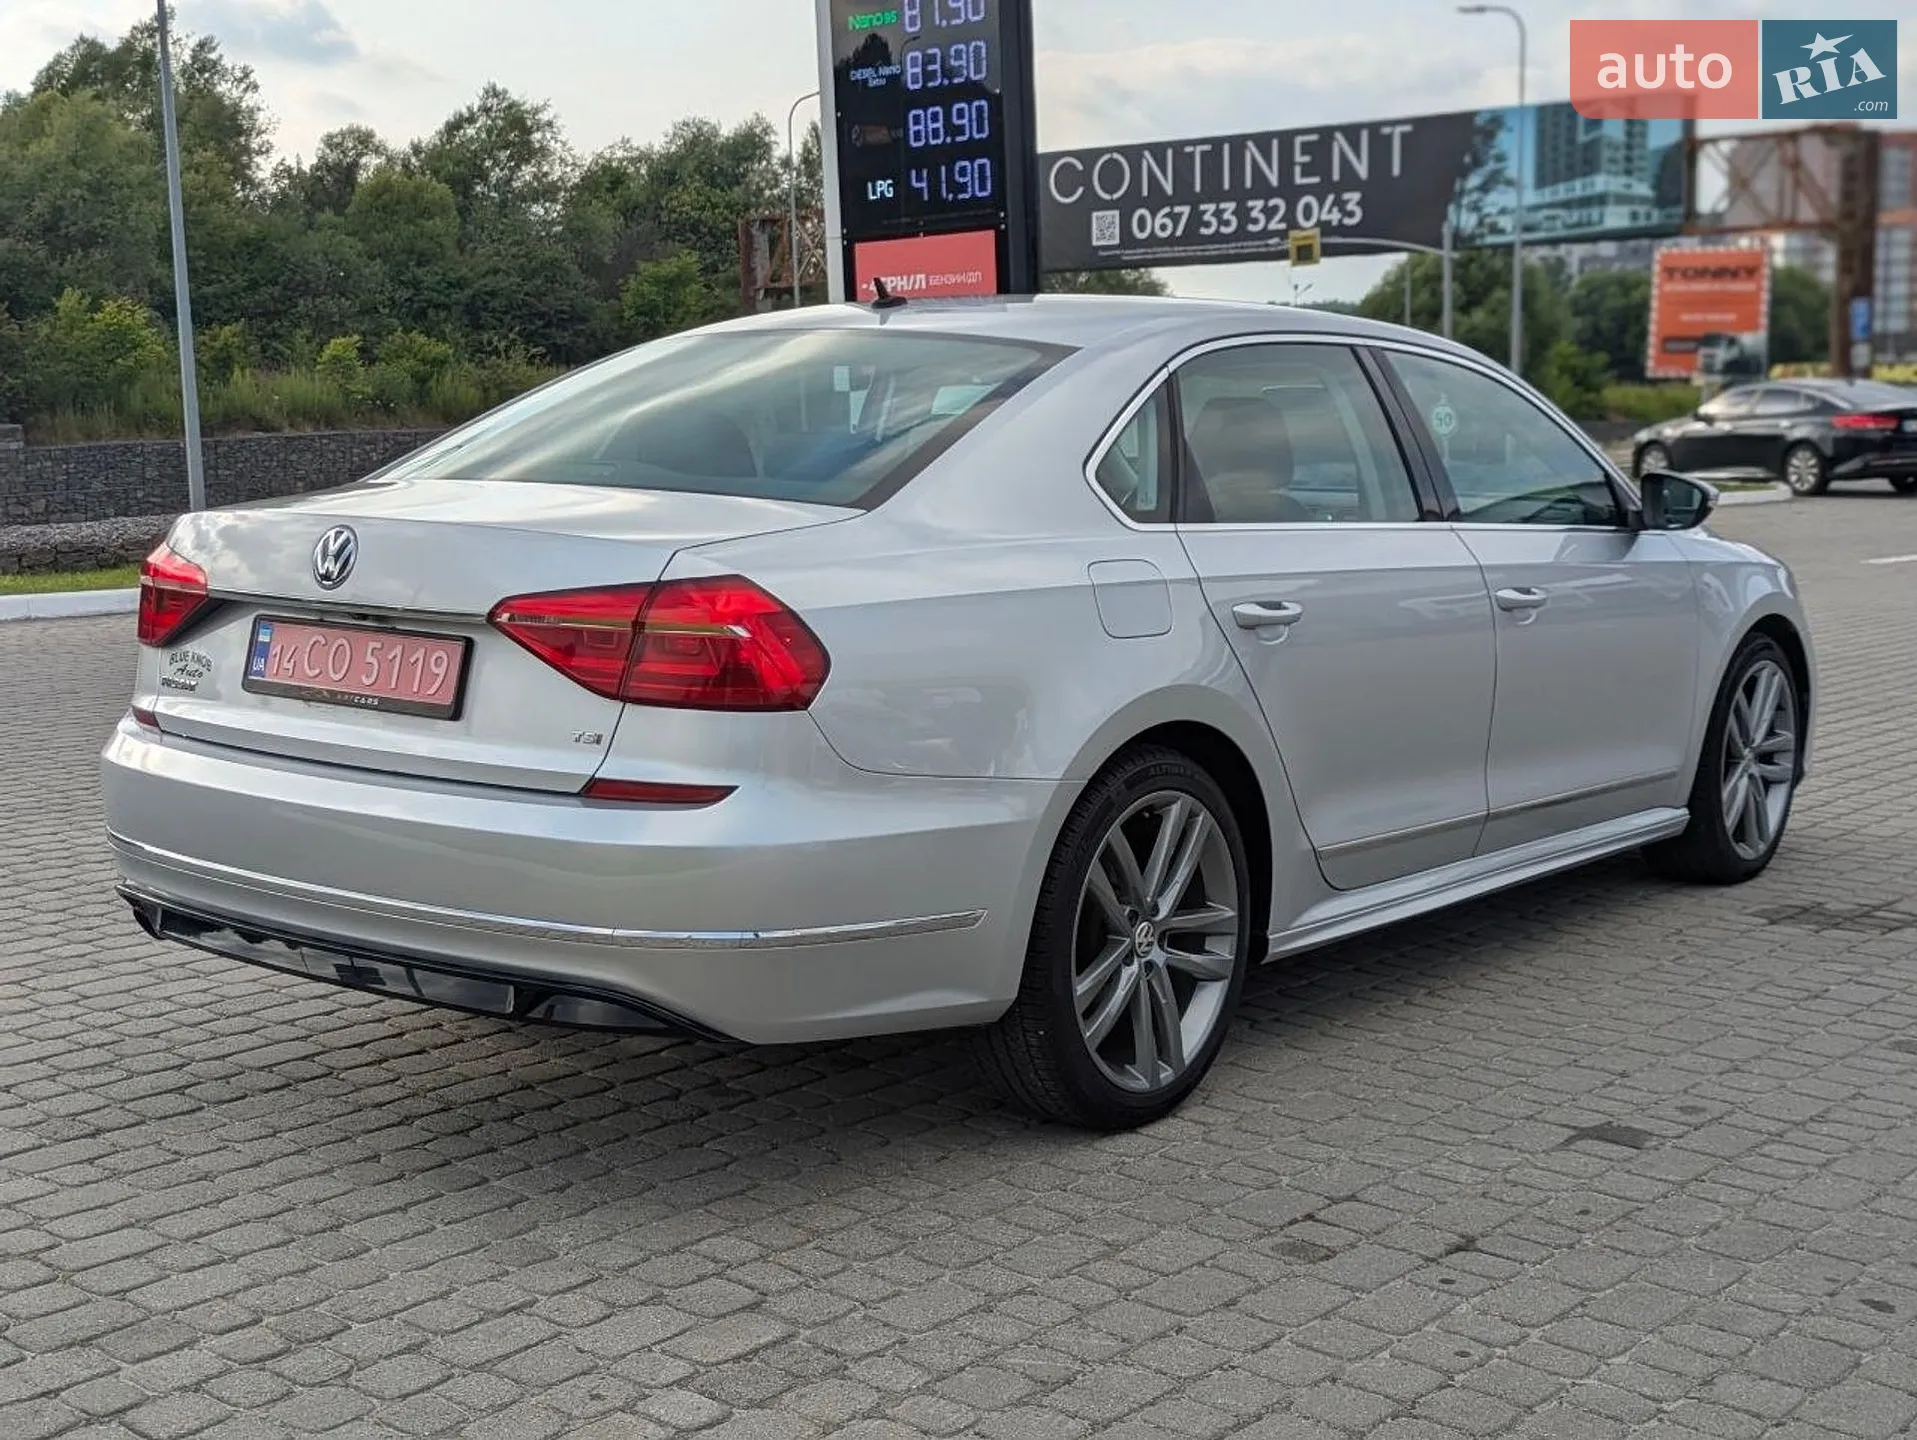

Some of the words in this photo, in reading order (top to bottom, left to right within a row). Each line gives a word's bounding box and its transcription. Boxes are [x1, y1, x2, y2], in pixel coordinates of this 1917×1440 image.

[907, 40, 987, 91] 83.90
[908, 99, 990, 148] 88.90
[910, 158, 992, 202] 41.90
[1048, 124, 1414, 204] CONTINENT
[867, 179, 894, 200] LPG
[1131, 204, 1192, 240] 067
[1199, 201, 1239, 235] 33
[1246, 198, 1287, 232] 32
[1296, 192, 1364, 228] 043
[252, 656, 265, 671] UA
[272, 643, 298, 678] 14
[303, 634, 353, 683] CO
[361, 641, 449, 696] 5119
[571, 730, 604, 745] TSI
